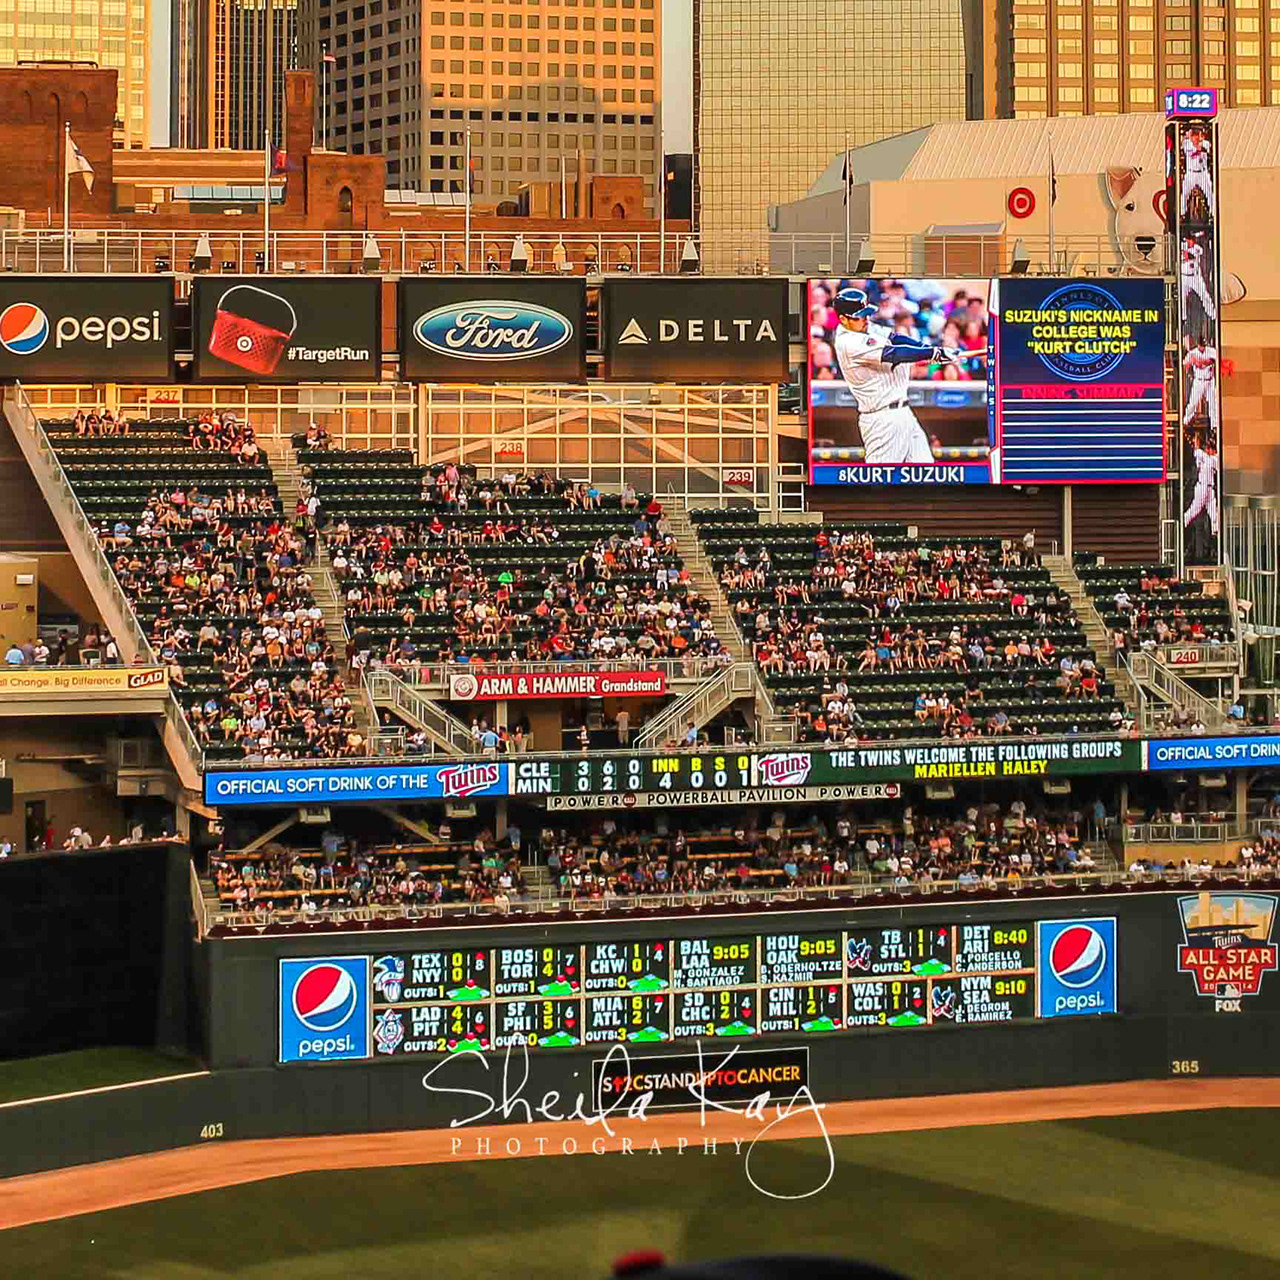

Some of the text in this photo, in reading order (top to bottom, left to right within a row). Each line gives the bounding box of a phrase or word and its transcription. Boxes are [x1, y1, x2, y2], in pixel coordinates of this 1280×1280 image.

[1179, 94, 1210, 108] 8:22
[1005, 310, 1158, 323] SUZUKI'S NICKNAME IN
[56, 310, 161, 349] pepsi
[445, 311, 540, 349] Ford
[660, 319, 778, 342] DELTA
[1033, 325, 1131, 338] COLLEGE WAS
[1028, 341, 1137, 354] "KURT CLUTCH"
[288, 347, 369, 365] #TargetRun
[987, 345, 996, 406] TWINS
[155, 390, 178, 401] 237
[500, 442, 522, 453] 238
[729, 471, 750, 482] 239
[900, 466, 964, 482] SUZUKI
[55, 676, 70, 688] Big
[129, 671, 163, 688] GLAD
[480, 677, 661, 695] ARM & HAMMER Grandstand
[830, 741, 1122, 767] THE TWINS WELCOME THE FOLLOWING GROUPS
[1157, 747, 1213, 761] OFFICIAL
[1216, 745, 1248, 758] SOFT
[519, 756, 725, 777] CLE 3 6 INN B S
[758, 754, 811, 786] Twins
[915, 760, 1047, 778] MARIELLEN HALEY
[217, 764, 500, 797] OFFICIAL SOFT DRINK OF THE Twins
[517, 773, 672, 793] MIN 0 2 4
[554, 786, 882, 808] POWER POWERBALL PAVILION POWER
[882, 930, 901, 944] TB
[964, 926, 991, 940] DET
[994, 929, 1027, 945] 8:40
[680, 940, 710, 955] BAL
[766, 936, 799, 950] HOU
[800, 940, 836, 955] 9:05
[963, 940, 990, 954] ARI
[1213, 933, 1242, 949] Twins
[502, 949, 533, 964] BOS
[596, 945, 617, 959] KC
[713, 944, 749, 959] 9:05
[766, 950, 798, 965] OAK
[880, 944, 906, 959] STL
[1186, 950, 1272, 965] ALL STAR
[412, 954, 441, 969] TEX
[591, 959, 625, 974] CHW
[682, 955, 710, 969] LAA
[412, 969, 441, 983] NYY
[502, 964, 533, 978] TOR
[1203, 966, 1254, 980] GAME
[852, 983, 884, 997] WAS
[961, 977, 991, 991] NYM
[995, 979, 1026, 995] 9:10
[684, 993, 704, 1007] SD
[769, 988, 794, 1002] CIN
[963, 990, 990, 1004] SEA
[1055, 992, 1101, 1012] pepsi
[508, 1002, 526, 1017] SF
[593, 997, 622, 1012] MIA
[769, 1003, 796, 1016] MIL
[854, 997, 882, 1011] COL
[1215, 999, 1241, 1012] FOX
[412, 1007, 441, 1021] LAD
[593, 1012, 621, 1026] ATL
[682, 1007, 711, 1021] CHC
[413, 1022, 439, 1037] PIT
[503, 1017, 532, 1031] PHI
[299, 1034, 351, 1056] pepsi
[1172, 1061, 1199, 1074] 365
[200, 1123, 224, 1138] 403
